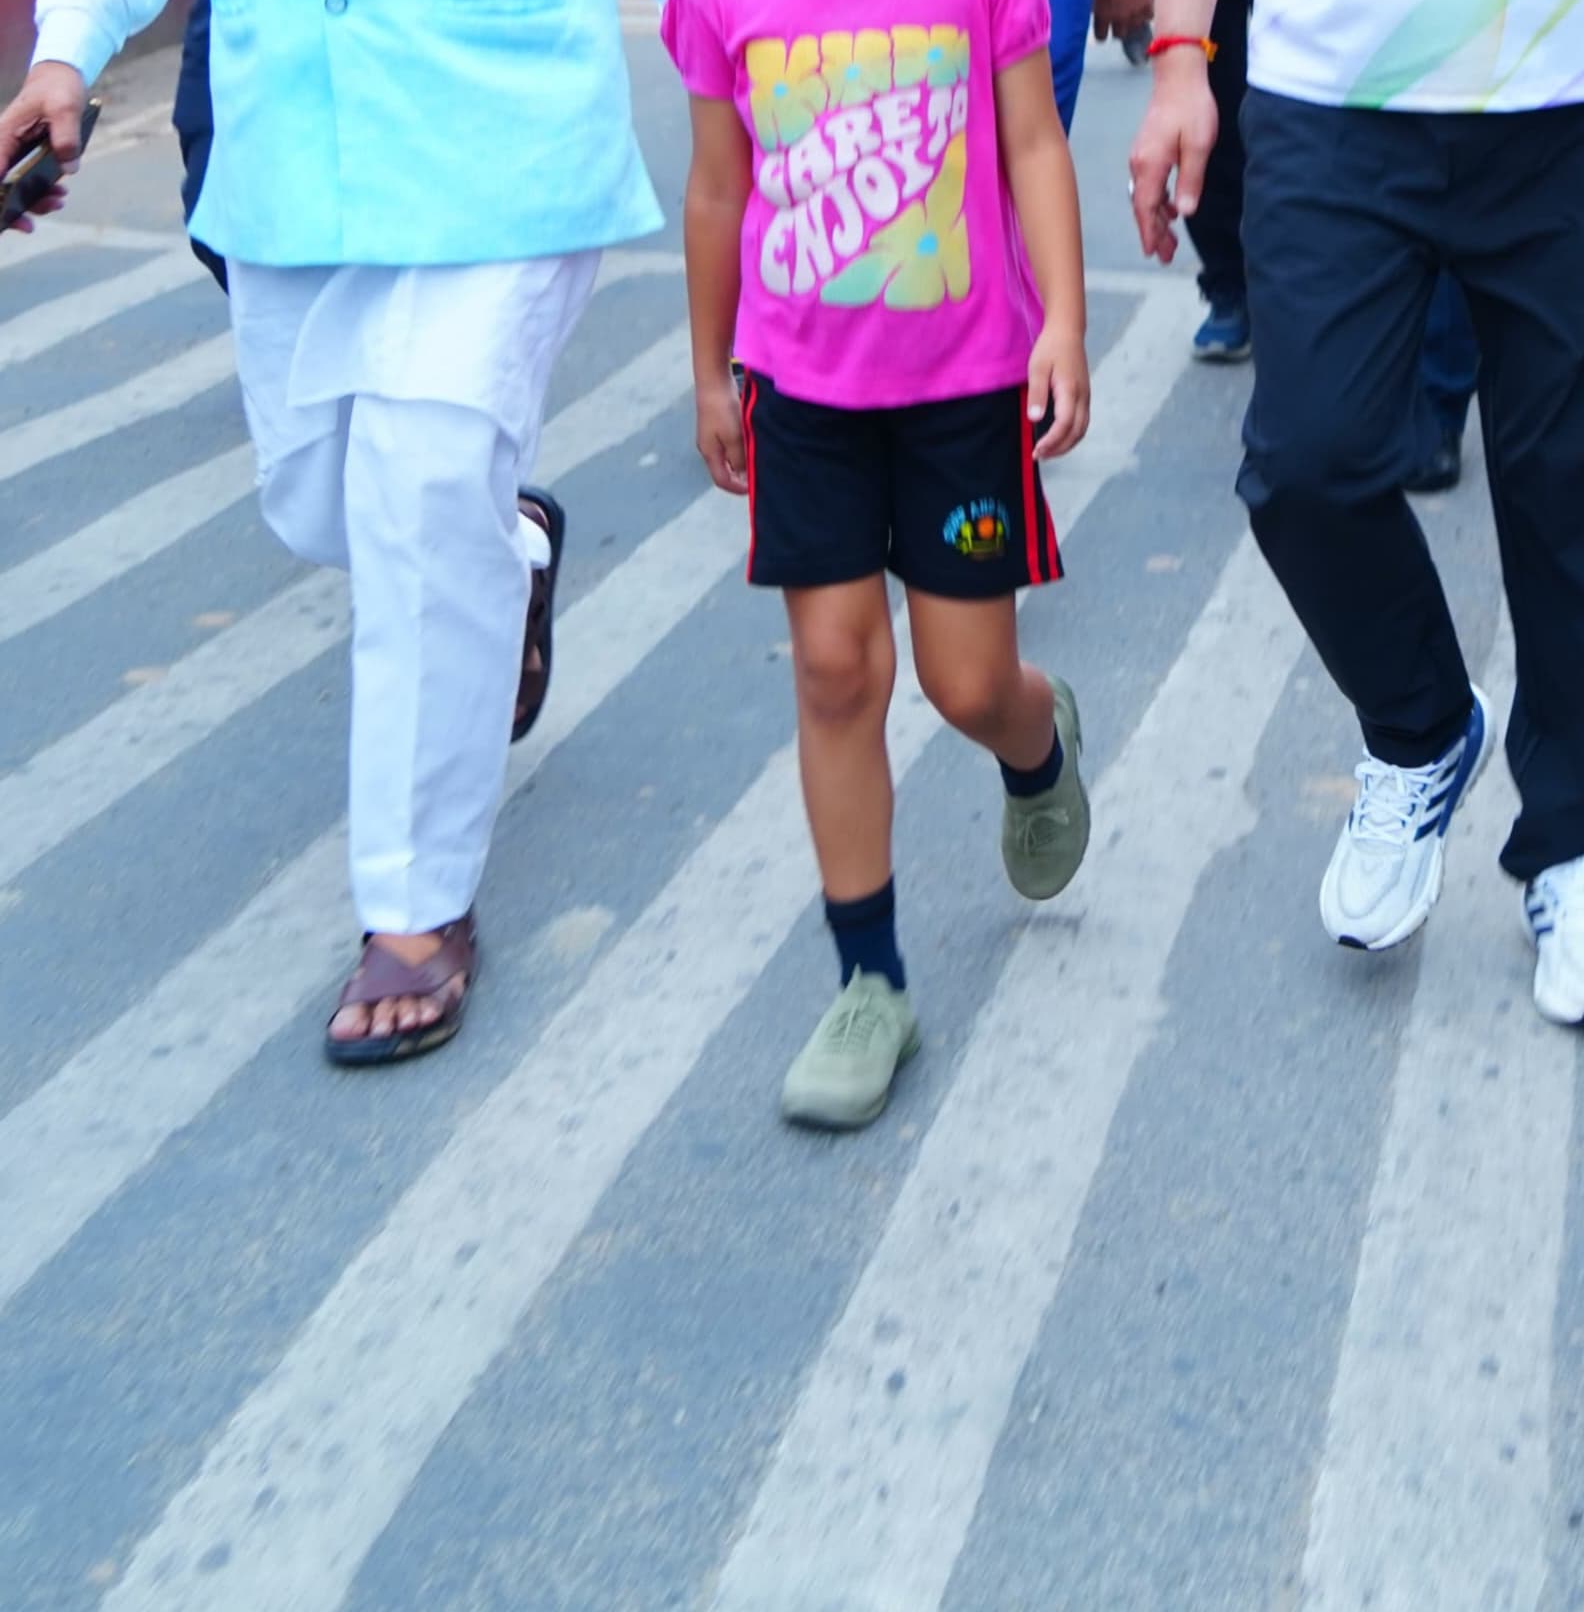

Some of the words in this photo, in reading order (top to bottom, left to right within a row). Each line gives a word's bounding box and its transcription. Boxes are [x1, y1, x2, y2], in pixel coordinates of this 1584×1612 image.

[759, 87, 922, 209] CARE
[927, 86, 968, 161] TO
[760, 138, 935, 298] ENJOY
